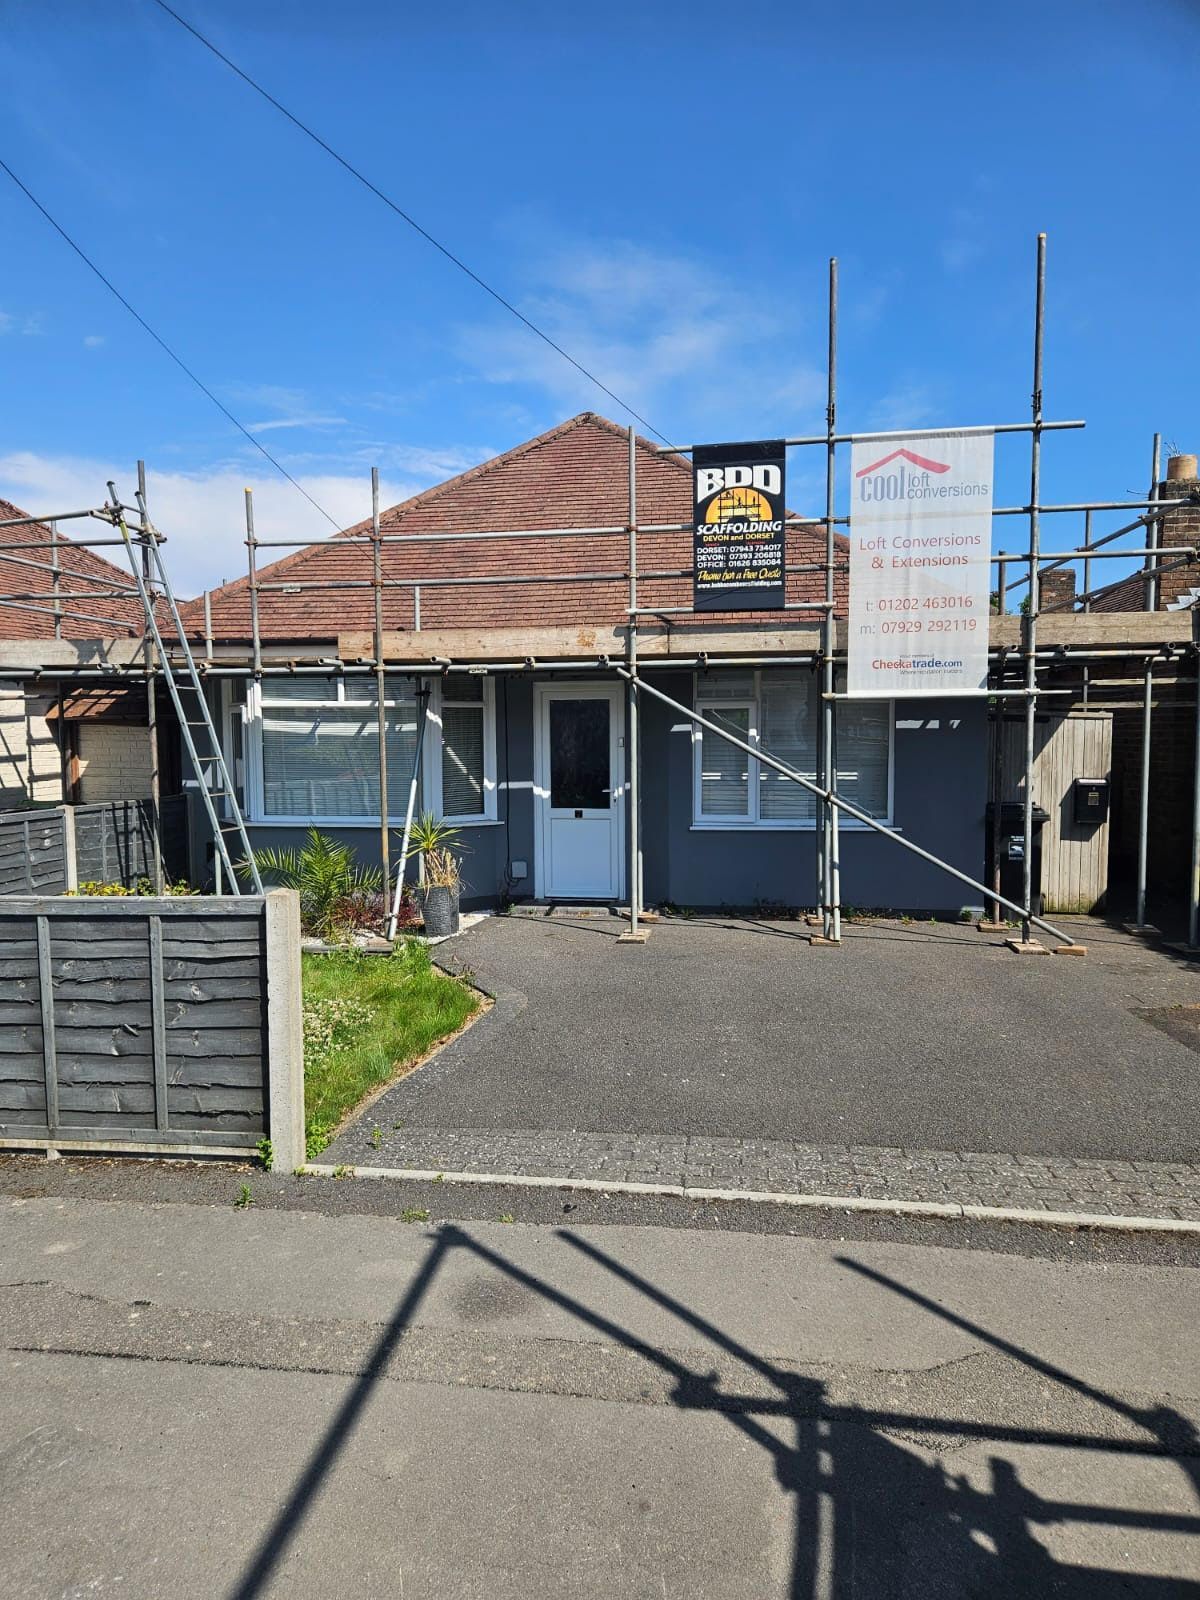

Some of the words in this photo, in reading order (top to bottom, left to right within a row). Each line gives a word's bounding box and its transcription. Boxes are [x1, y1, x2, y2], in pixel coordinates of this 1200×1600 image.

[697, 465, 781, 504] BDD
[860, 466, 905, 502] cool
[908, 472, 930, 488] loft
[907, 482, 988, 500] conversions
[696, 521, 782, 535] SCAFFOLDING
[860, 536, 887, 550] Loft
[892, 533, 981, 548] Conversions
[871, 556, 884, 568] &
[892, 553, 968, 568] Extensions
[698, 570, 721, 581] Phone
[743, 568, 758, 579] Free
[758, 568, 781, 579] Quote
[866, 601, 873, 611] t:
[878, 598, 919, 611] 01202
[922, 596, 973, 609] 463016
[860, 625, 876, 634] m:
[881, 621, 922, 634] 07929
[928, 619, 977, 632] 292119
[872, 658, 962, 670] Checkatrade.com
